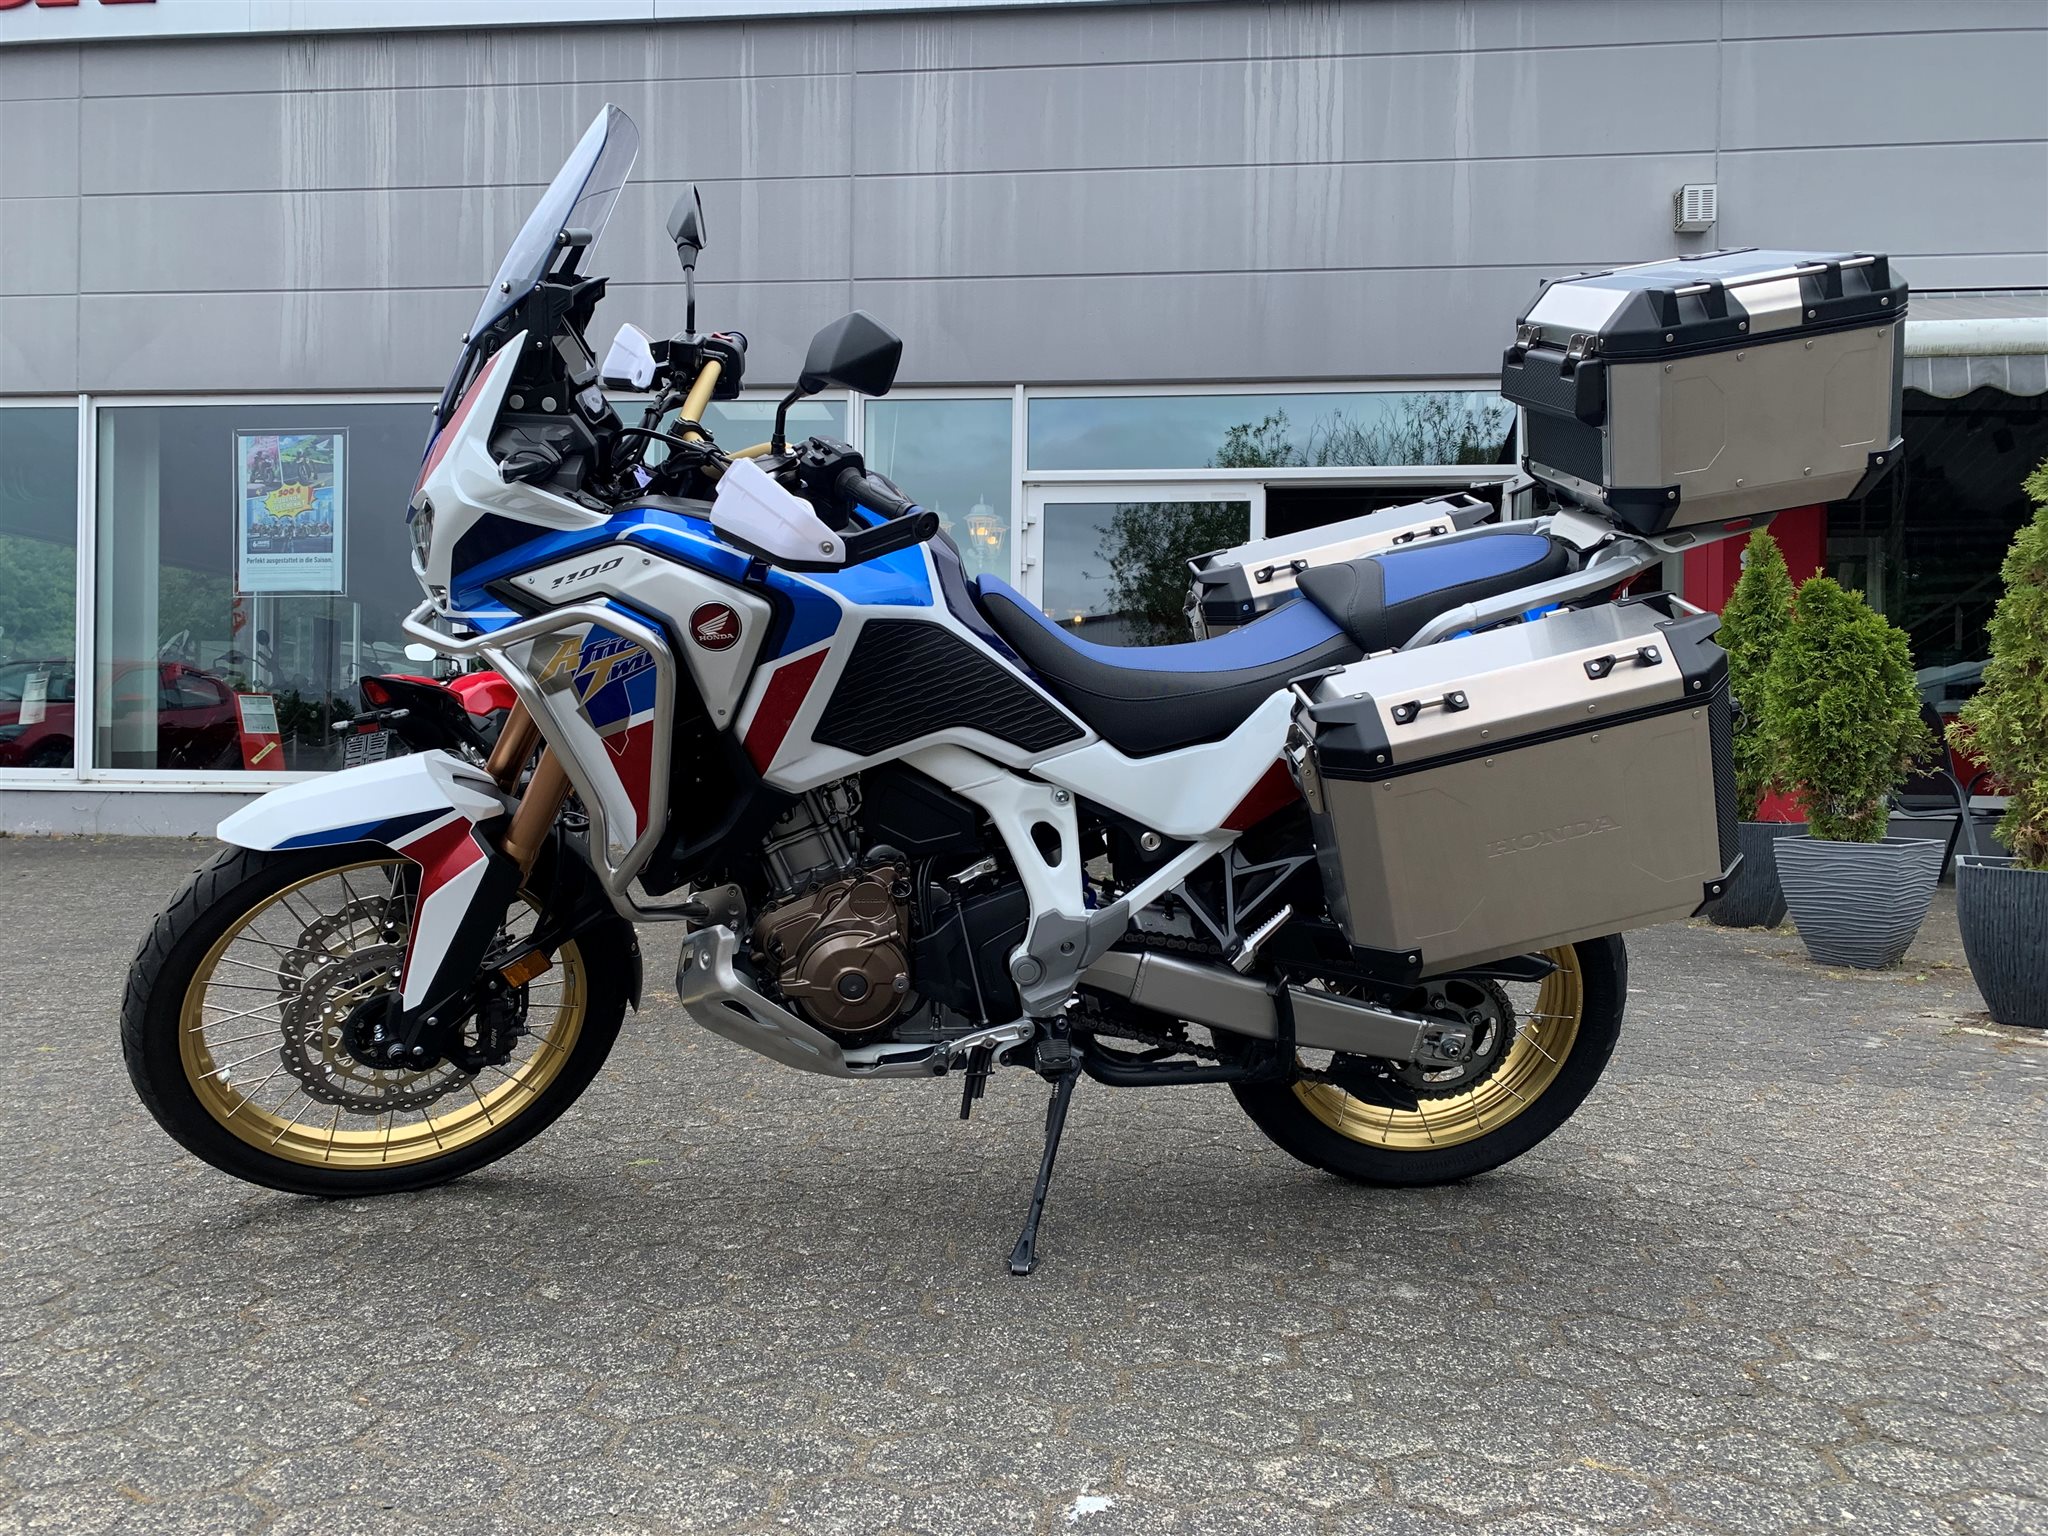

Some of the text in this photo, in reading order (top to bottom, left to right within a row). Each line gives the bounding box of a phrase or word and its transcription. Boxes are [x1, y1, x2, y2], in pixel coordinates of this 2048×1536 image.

[266, 557, 298, 566] ausgestattet
[299, 556, 304, 564] in
[305, 556, 313, 564] die
[551, 556, 625, 590] 1100
[698, 632, 736, 642] HONDA
[537, 636, 639, 684] Afric
[1486, 815, 1622, 859] HONDA
